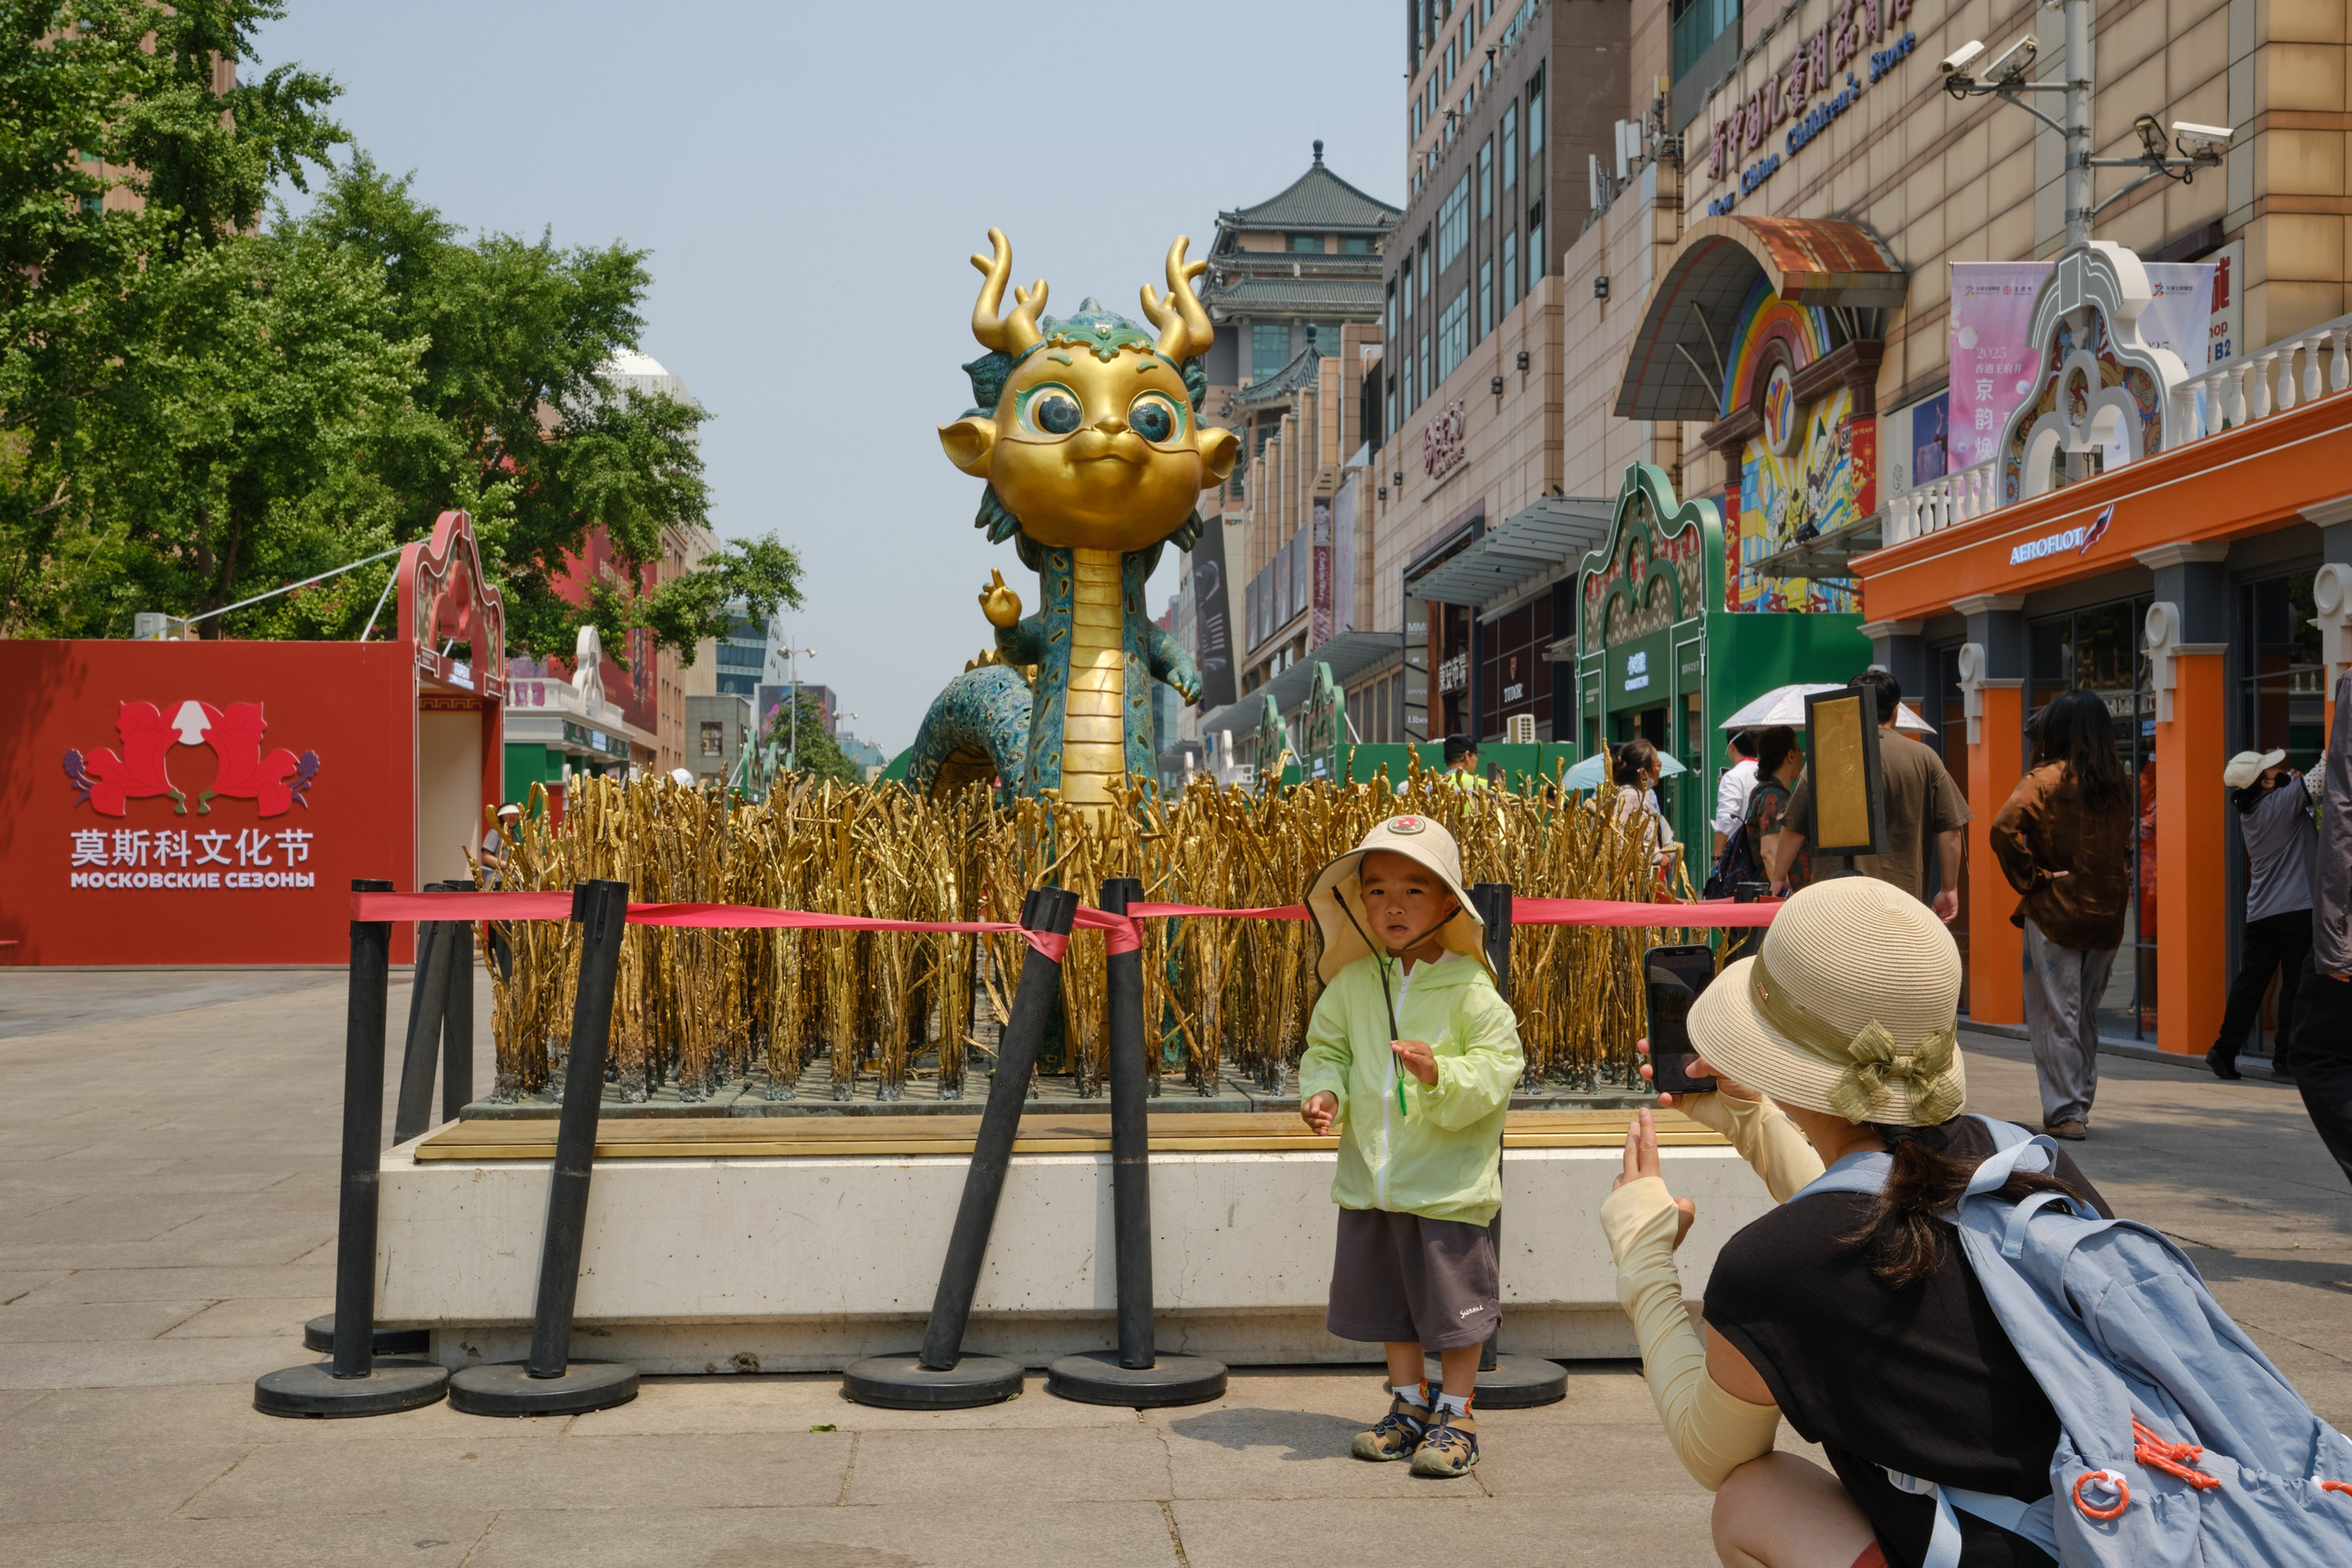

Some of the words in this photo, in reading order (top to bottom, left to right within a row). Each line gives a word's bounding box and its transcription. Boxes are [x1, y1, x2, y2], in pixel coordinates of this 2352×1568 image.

[1708, 191, 1736, 216] New
[1740, 152, 1781, 197] China
[1785, 72, 1861, 155] Children's
[1869, 31, 1917, 84] Store
[1976, 346, 2007, 359] 2025
[2214, 338, 2231, 361] B2
[2009, 526, 2086, 565] AEROFLOT
[1504, 682, 1524, 703] TUDOR
[71, 829, 313, 867] 莫斯科文化节
[71, 873, 220, 888] МОСКОВСКИЕ
[224, 873, 314, 888] СЕЗОНЫ
